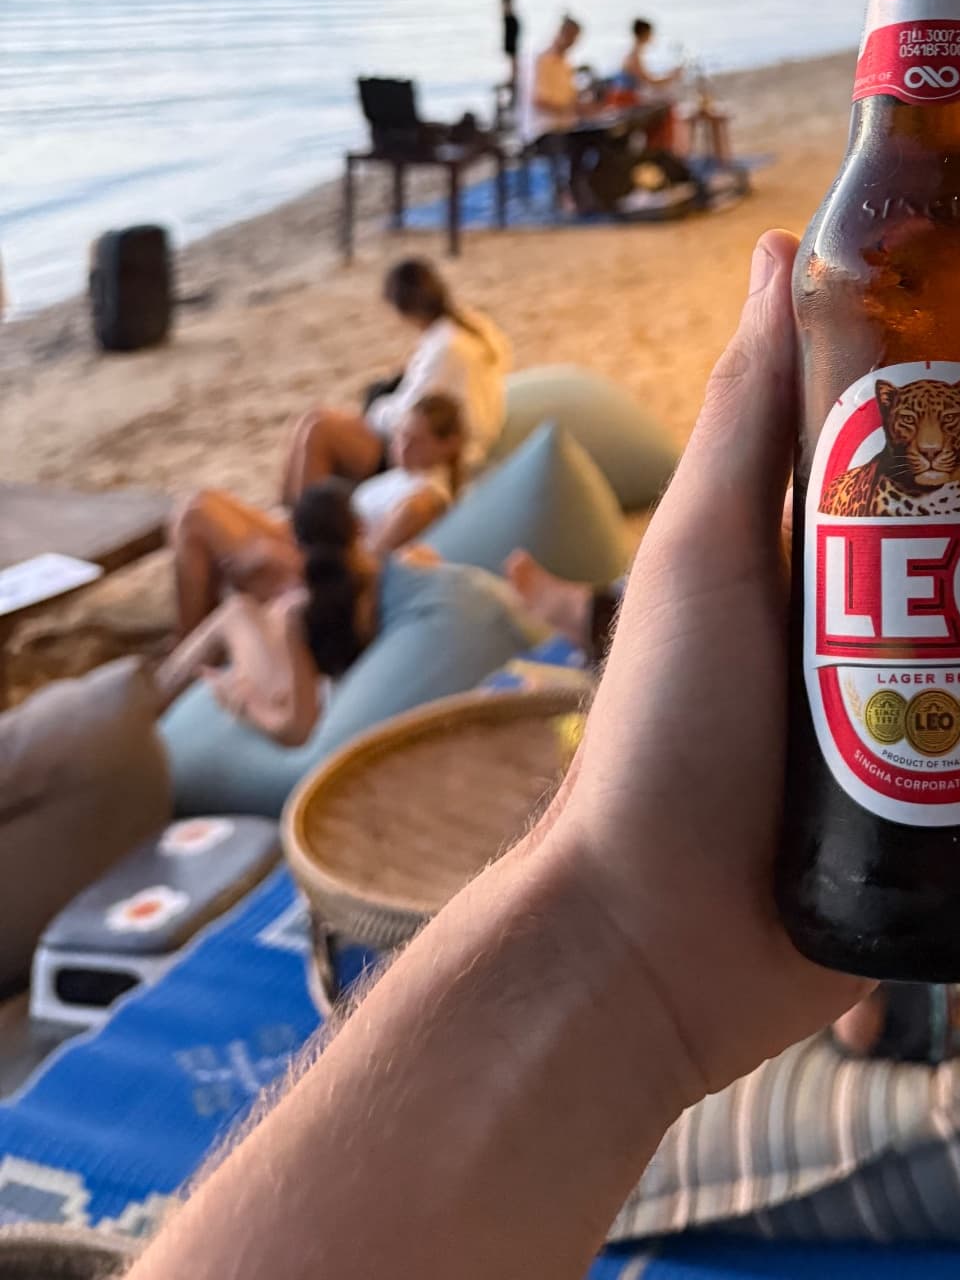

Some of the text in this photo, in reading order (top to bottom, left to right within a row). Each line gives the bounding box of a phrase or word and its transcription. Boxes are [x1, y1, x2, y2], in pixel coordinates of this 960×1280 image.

[877, 673, 935, 684] LAGER
[915, 712, 954, 731] LEO
[854, 748, 892, 784] SINGHA
[881, 749, 924, 768] PRODUCT
[926, 760, 939, 768] OF
